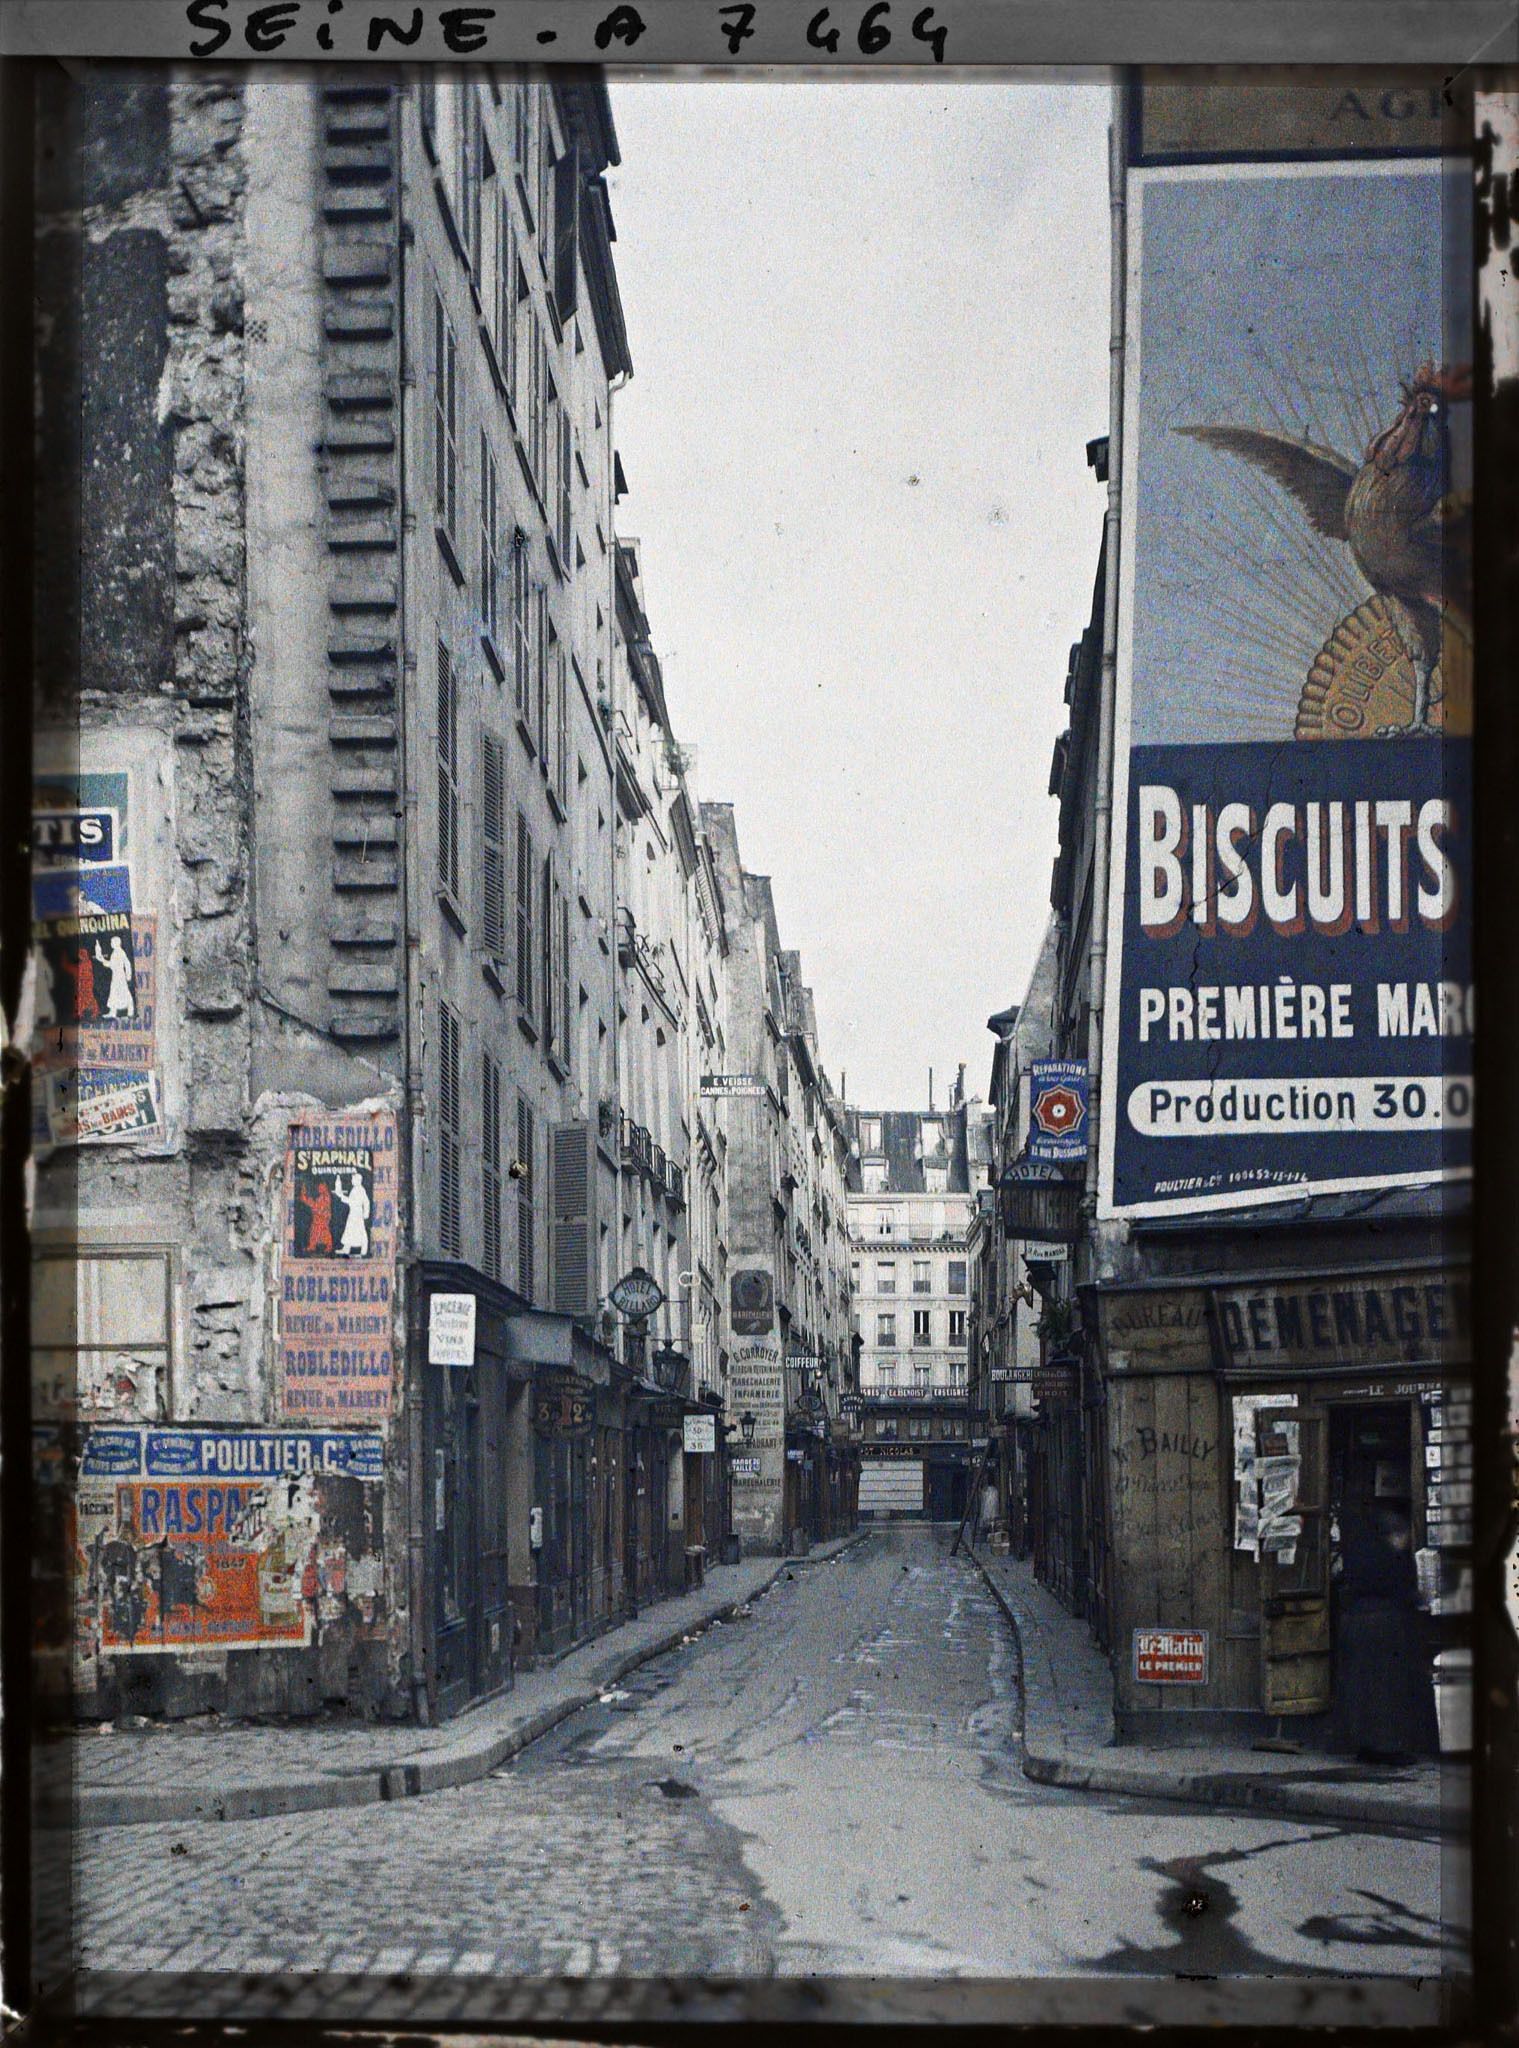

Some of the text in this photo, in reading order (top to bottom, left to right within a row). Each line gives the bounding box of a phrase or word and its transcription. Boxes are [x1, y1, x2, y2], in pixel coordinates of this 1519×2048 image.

[1138, 975, 1354, 1043] PREMIÈRE
[1149, 1082, 1355, 1124] Production
[284, 1275, 389, 1303] ROBLEDILLO
[285, 1350, 391, 1377] ROBLEDILLO
[991, 1368, 1033, 1382] BOULANGERI
[201, 1438, 312, 1474] POULTIER
[1136, 1427, 1215, 1463] BAILLY
[140, 1487, 253, 1534] RASPA
